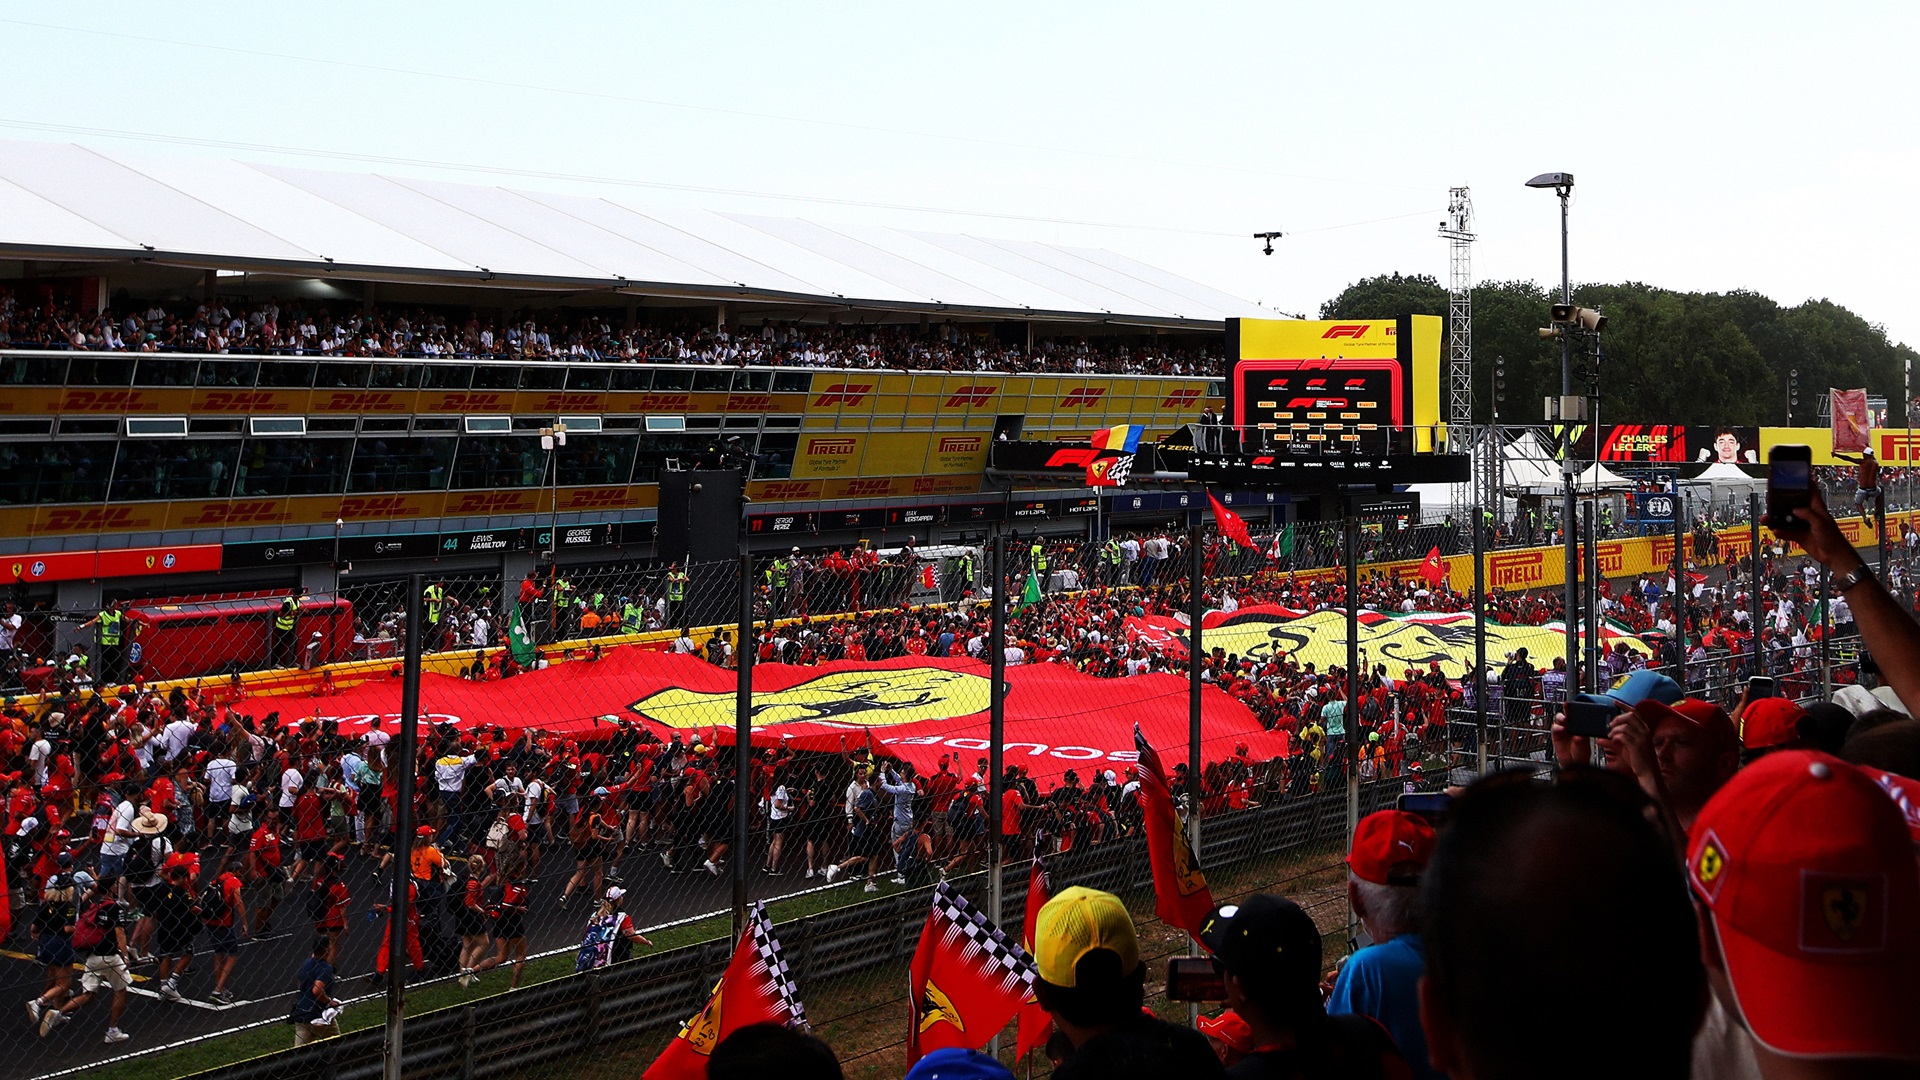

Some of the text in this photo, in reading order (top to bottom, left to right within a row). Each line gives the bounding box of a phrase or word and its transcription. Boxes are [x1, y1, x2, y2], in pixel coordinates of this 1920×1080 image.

[1321, 325, 1370, 338] F1
[63, 392, 142, 410] DHL
[202, 393, 274, 410] DHL
[327, 394, 392, 410] DHL
[438, 394, 500, 410] DHL
[543, 395, 599, 410] DHL
[640, 396, 690, 410] DHL
[725, 396, 771, 410] DHL
[813, 384, 873, 407] F1
[945, 386, 997, 407] F1
[1060, 388, 1106, 407] F1
[1161, 390, 1202, 408] F1
[938, 437, 981, 453] PIRELLI
[1621, 435, 1668, 443] CHARLES
[807, 439, 856, 455] PIRELLI
[1613, 443, 1656, 452] LECLERC
[761, 483, 811, 499] DHL
[848, 480, 890, 495] DHL
[458, 493, 524, 512] DHL
[570, 489, 628, 507] DHL
[198, 502, 277, 524] DHL
[337, 497, 405, 518] DHL
[1649, 502, 1671, 513] FIA
[45, 508, 132, 531] DHL
[752, 519, 763, 531] 11
[892, 512, 898, 523] 1
[904, 514, 934, 523] VERSTAPPEN
[567, 528, 592, 536] GEORGE
[773, 523, 791, 531] PEREZ
[443, 538, 458, 550] 44
[470, 540, 507, 550] HAMILTON
[472, 534, 493, 543] LEWIS
[538, 533, 551, 544] 63
[565, 535, 592, 544] RUSSELL
[1490, 552, 1542, 586] PIRELLI
